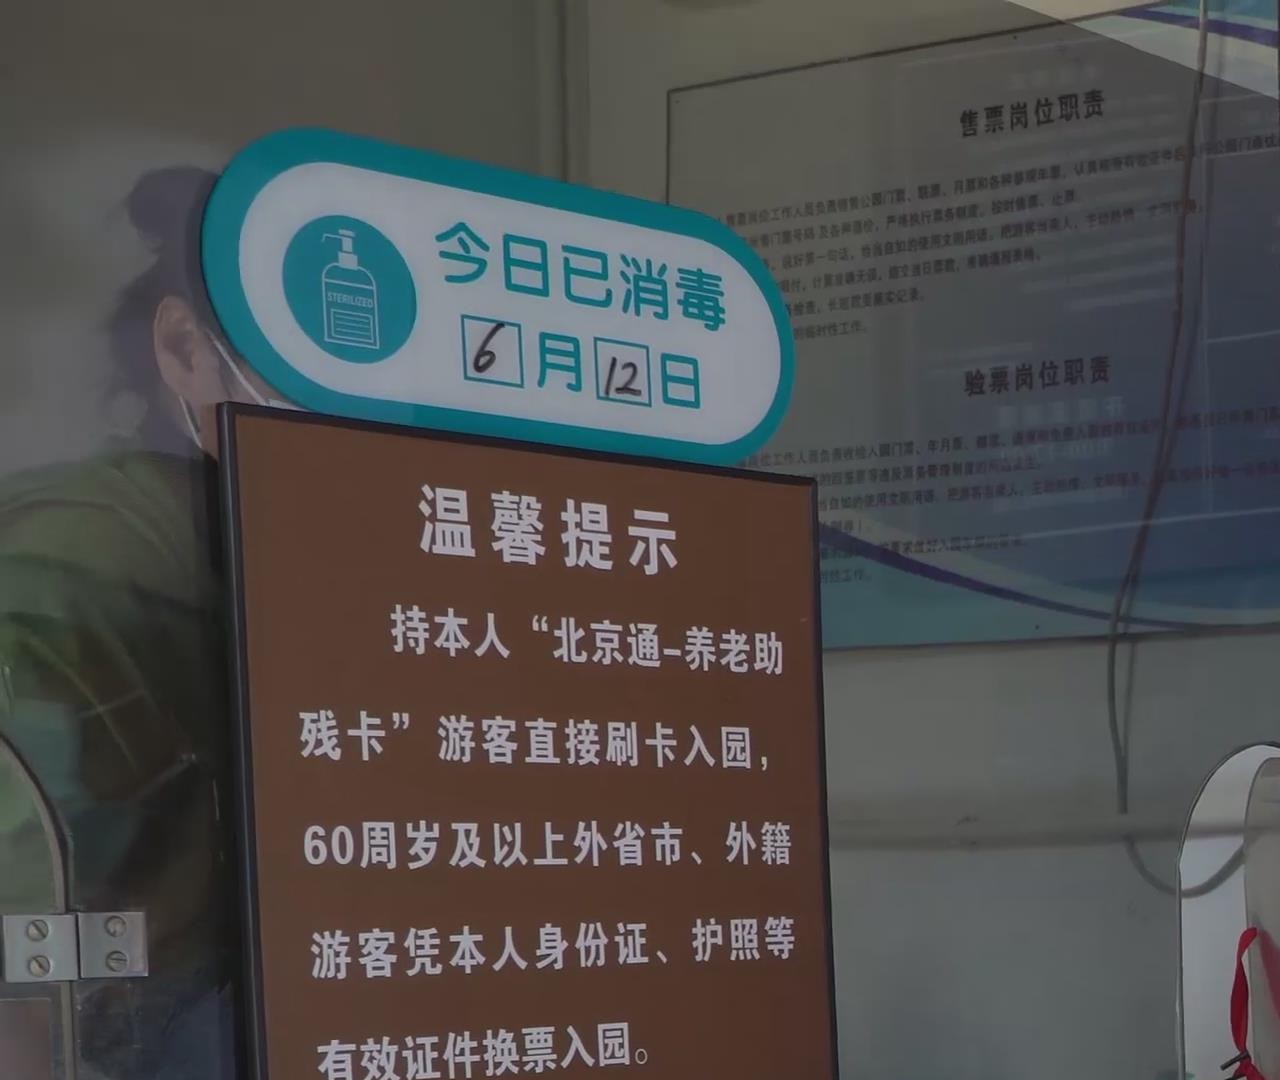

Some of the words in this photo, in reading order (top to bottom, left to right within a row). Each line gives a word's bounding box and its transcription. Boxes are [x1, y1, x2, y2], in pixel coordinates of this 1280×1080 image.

[959, 89, 1106, 138] 售票岗位职责
[434, 221, 727, 331] 今日已消毒
[963, 356, 1113, 396] 验票岗位职责
[418, 484, 679, 575] 温馨提示
[303, 821, 792, 870] 60周岁及以上外省市、外籍
[310, 916, 796, 980] 游客凭本人身份证、护照等
